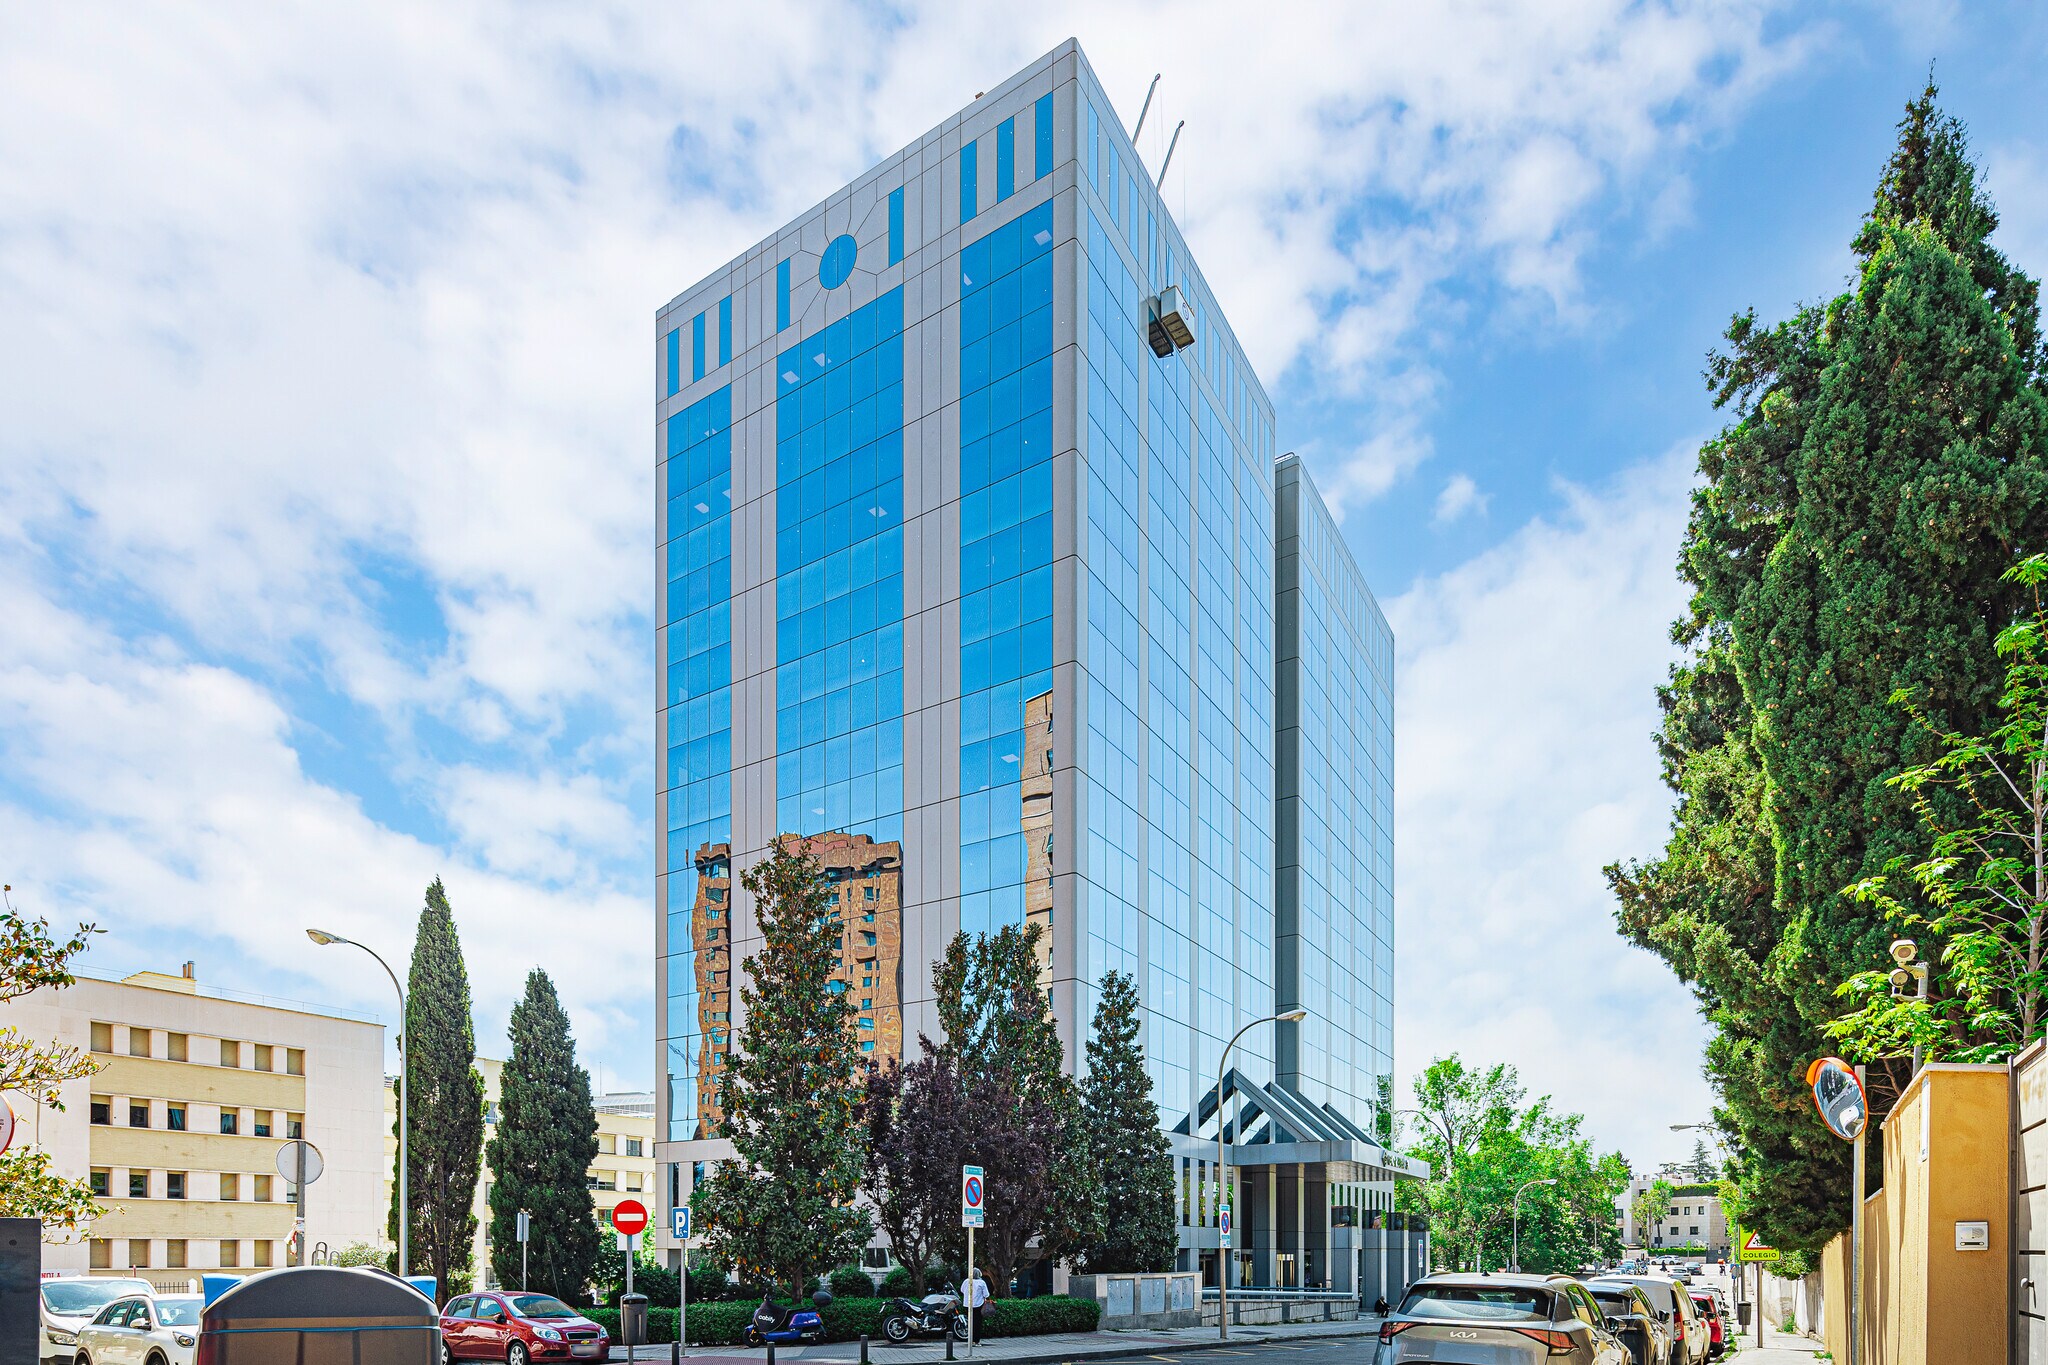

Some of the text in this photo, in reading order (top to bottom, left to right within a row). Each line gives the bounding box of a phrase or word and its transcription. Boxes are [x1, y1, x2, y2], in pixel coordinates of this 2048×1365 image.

[675, 1211, 686, 1235] P
[758, 1315, 775, 1324] cabify
[1449, 1331, 1478, 1339] KIA
